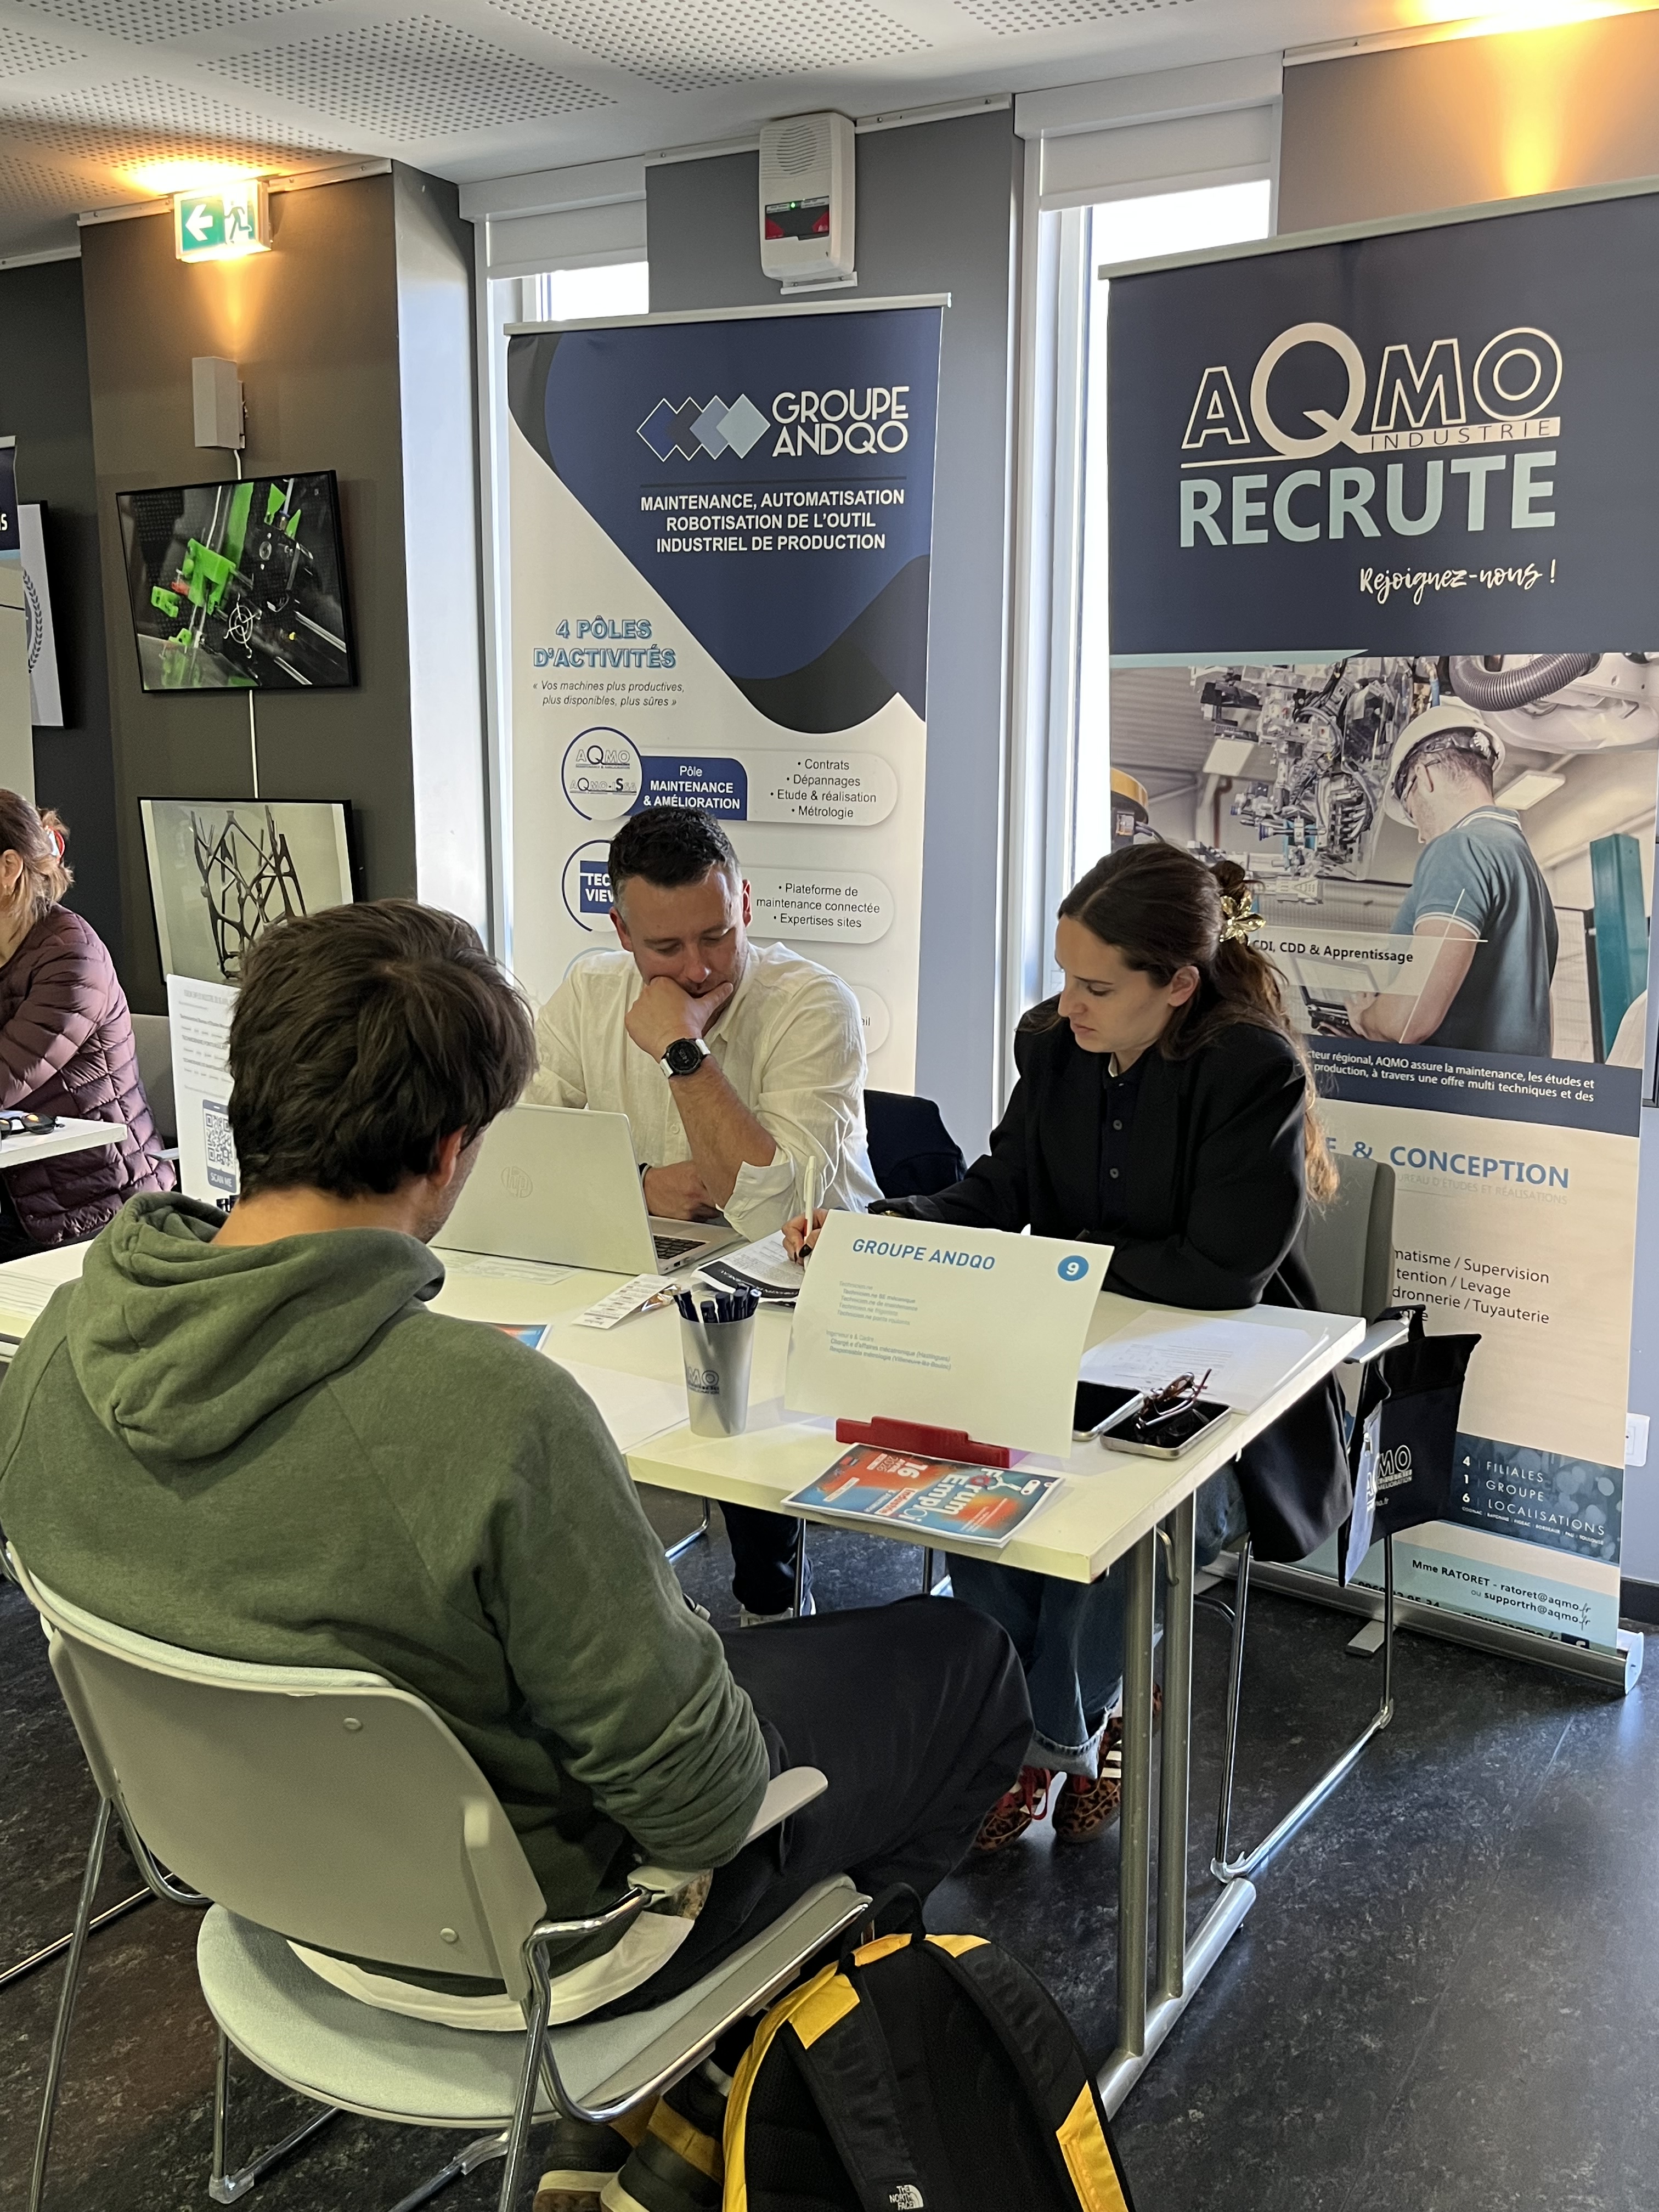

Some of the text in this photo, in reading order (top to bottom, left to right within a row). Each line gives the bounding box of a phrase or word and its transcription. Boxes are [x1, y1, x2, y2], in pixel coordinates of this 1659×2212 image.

[1181, 321, 1562, 460] AQMO
[772, 386, 910, 424] GROUPE
[772, 420, 909, 457] ANDQO
[1371, 419, 1550, 451] INDUSTRIE
[641, 489, 905, 511] MAINTENANCE, AUTOMATISATION
[1180, 451, 1557, 548] RECRUTE
[667, 512, 876, 532] ROBOTISATION DE L'OUTIL
[657, 533, 885, 552] INDUSTRIEL DE PRODUCTION
[1360, 558, 1558, 605] Rejoignez-nous !
[555, 615, 652, 639] 4 PÔLES
[533, 644, 676, 668] D'ACTIVITÉS
[541, 680, 557, 690] Vos
[560, 681, 604, 691] machines
[606, 681, 626, 693] plus
[628, 681, 685, 693] productives,
[543, 695, 561, 706] plus
[563, 695, 618, 707] disponibles,
[620, 696, 640, 707] plus
[643, 696, 669, 706] sûres
[575, 744, 630, 765] AQMO
[805, 758, 850, 770] Contrats
[679, 765, 702, 777] Pôle
[793, 774, 861, 788] Dépannages
[650, 780, 733, 794] MAINTENANCE
[777, 789, 877, 803] Etude & réalisation
[643, 793, 740, 809] & AMÉLIORATION
[798, 805, 854, 820] Métrologie
[582, 873, 611, 887] TEC
[785, 883, 859, 896] Plateforme de
[757, 897, 881, 913] maintenance connectée
[780, 913, 862, 928] Expertises sites
[1279, 942, 1306, 954] CDD
[1310, 944, 1320, 955] &
[1323, 945, 1413, 964] Apprentissage
[1332, 1052, 1373, 1066] régional,
[1375, 1057, 1409, 1069] AQMO
[1410, 1060, 1443, 1073] assure
[1444, 1063, 1454, 1073] la
[1455, 1065, 1526, 1082] maintenance,
[1528, 1071, 1543, 1082] les
[1545, 1073, 1582, 1087] études
[1583, 1079, 1595, 1089] et
[1313, 1063, 1594, 1102] production, à travers une offre multi techniques et des
[1352, 1141, 1373, 1159] &
[1390, 1146, 1569, 1188] CONCEPTION
[1397, 1173, 1430, 1185] UREAU
[1481, 1185, 1492, 1194] ET
[1496, 1184, 1568, 1205] RÉALISATIONS
[852, 1238, 1080, 1277] GROUPE ANDQO 9
[1394, 1249, 1451, 1267] matisme
[1464, 1258, 1549, 1284] Supervision
[1396, 1267, 1447, 1286] tention
[1460, 1277, 1511, 1299] Levage
[1392, 1286, 1461, 1308] dronnerie
[1472, 1299, 1549, 1324] Tuyauterie
[897, 1462, 929, 1479] 16
[1462, 1455, 1544, 1483] 4 FILIALES
[1464, 1474, 1544, 1502] 1 GROUPE
[1462, 1493, 1605, 1536] 6 LOCALISATIONS
[1412, 1559, 1438, 1573] Mme
[1441, 1566, 1491, 1587] RATORET
[1500, 1583, 1592, 1618] ratoret@aqmo.fr
[1483, 1592, 1591, 1631] supportrh@aqmo.fr
[889, 2192, 912, 2203] NORTH
[896, 2185, 910, 2194] THE
[898, 2200, 914, 2211] FACE
